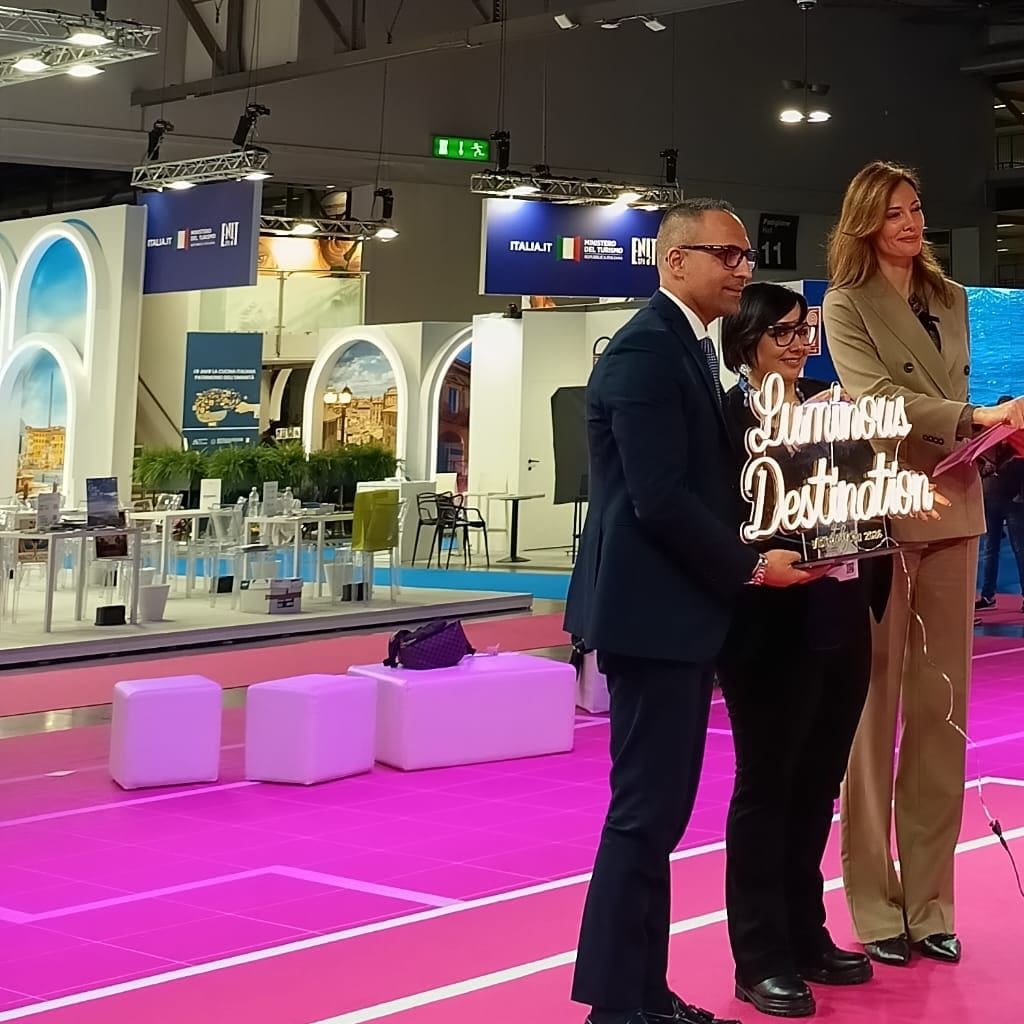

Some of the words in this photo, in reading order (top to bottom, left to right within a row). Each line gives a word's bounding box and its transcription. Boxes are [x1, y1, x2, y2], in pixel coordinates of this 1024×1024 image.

[509, 240, 553, 253] ITALIA.IT
[761, 241, 782, 265] 11
[745, 372, 912, 454] Luminous
[739, 452, 935, 543] Destination
